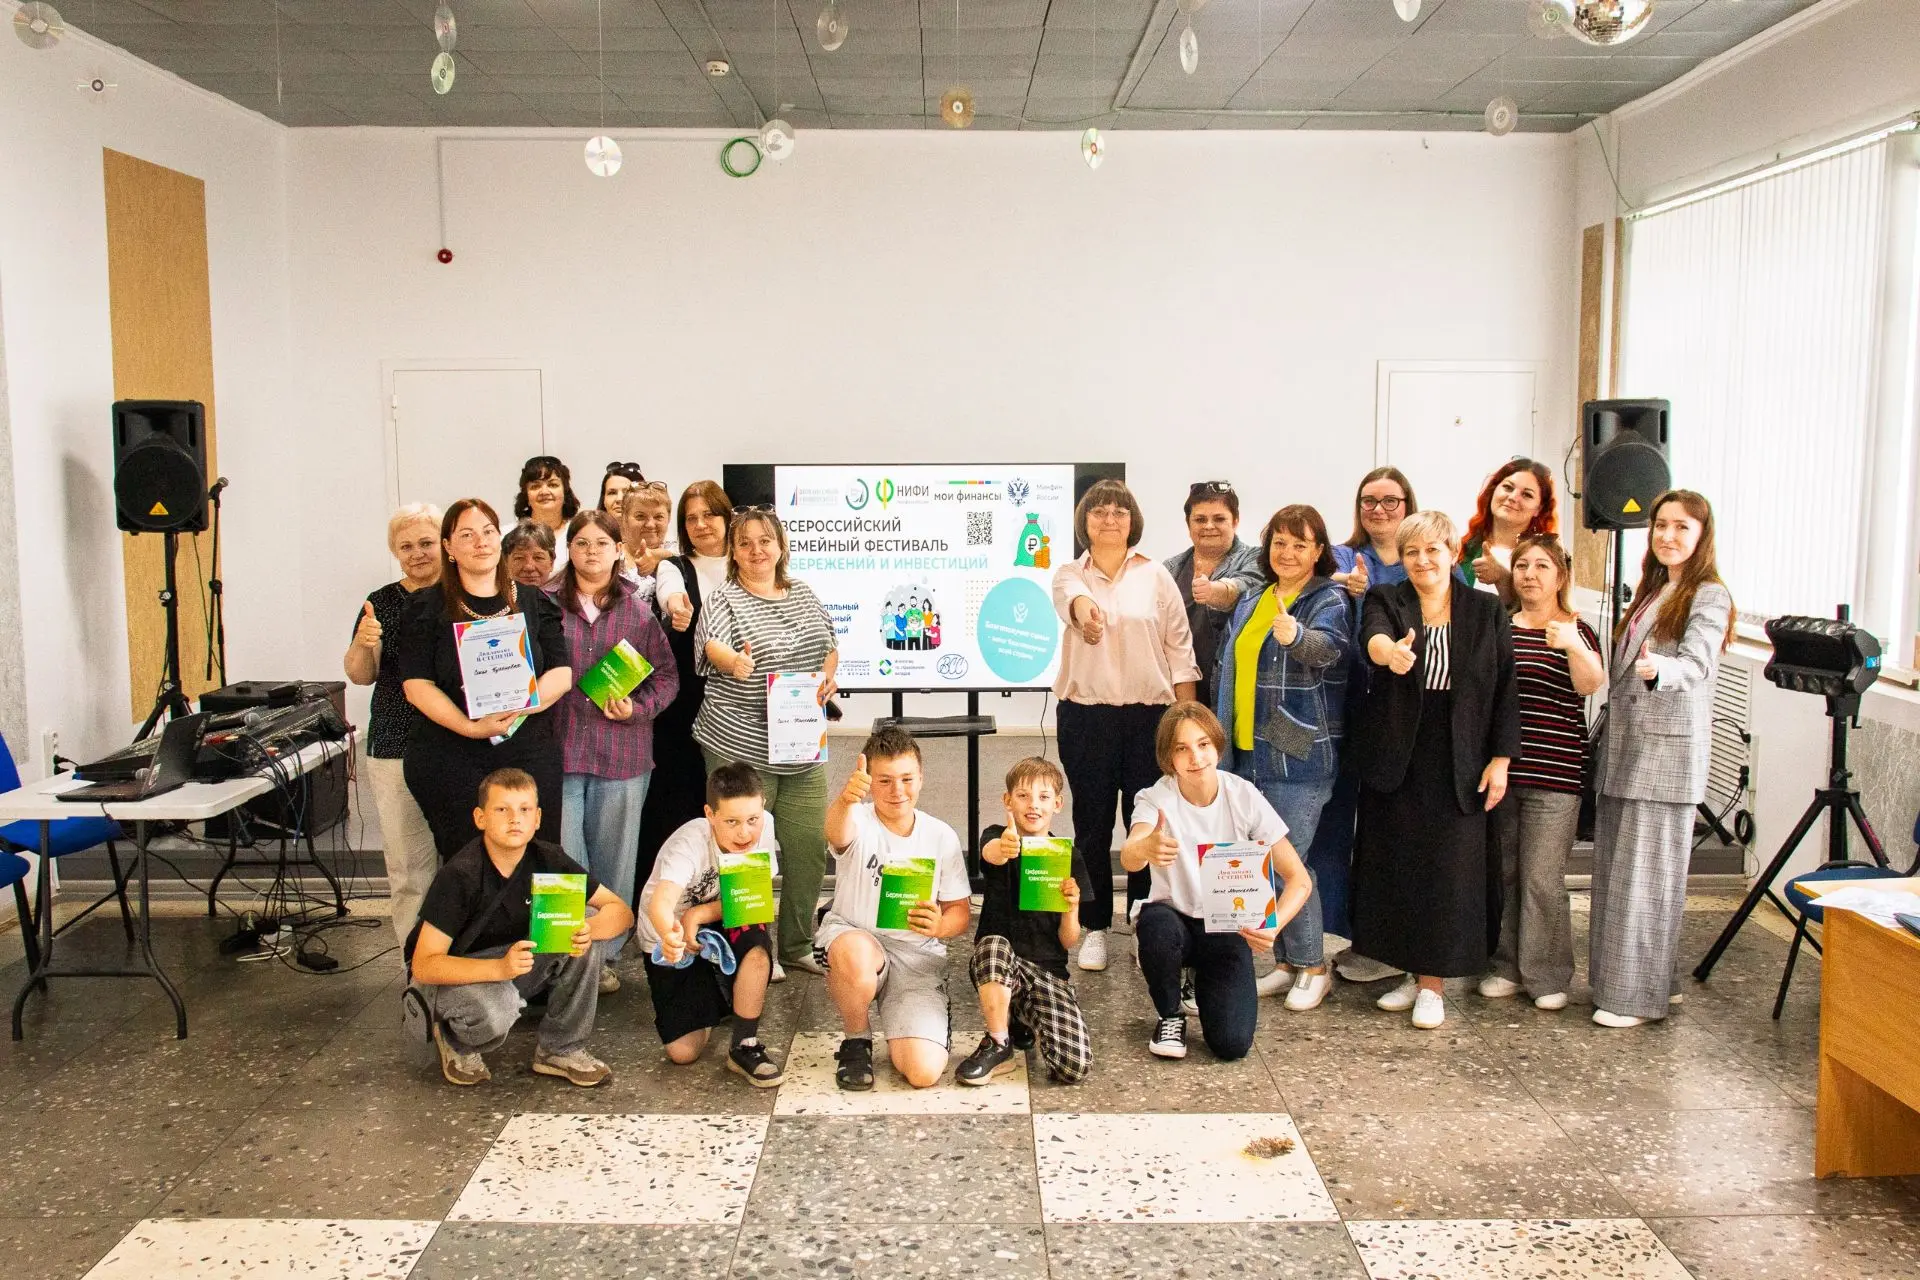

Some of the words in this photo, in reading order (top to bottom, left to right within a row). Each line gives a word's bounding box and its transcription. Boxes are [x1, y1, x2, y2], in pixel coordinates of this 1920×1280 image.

[896, 485, 930, 497] НИФИ
[934, 493, 955, 501] мои
[956, 489, 1002, 504] финансы
[789, 536, 860, 552] ЕМЕЙНЫЙ
[864, 539, 949, 552] ФЕСТИВАЛЬ
[789, 555, 873, 570] БЕРЕЖЕНИЙ
[880, 558, 890, 570] И
[894, 555, 989, 571] ИНВЕСТИЦИЙ
